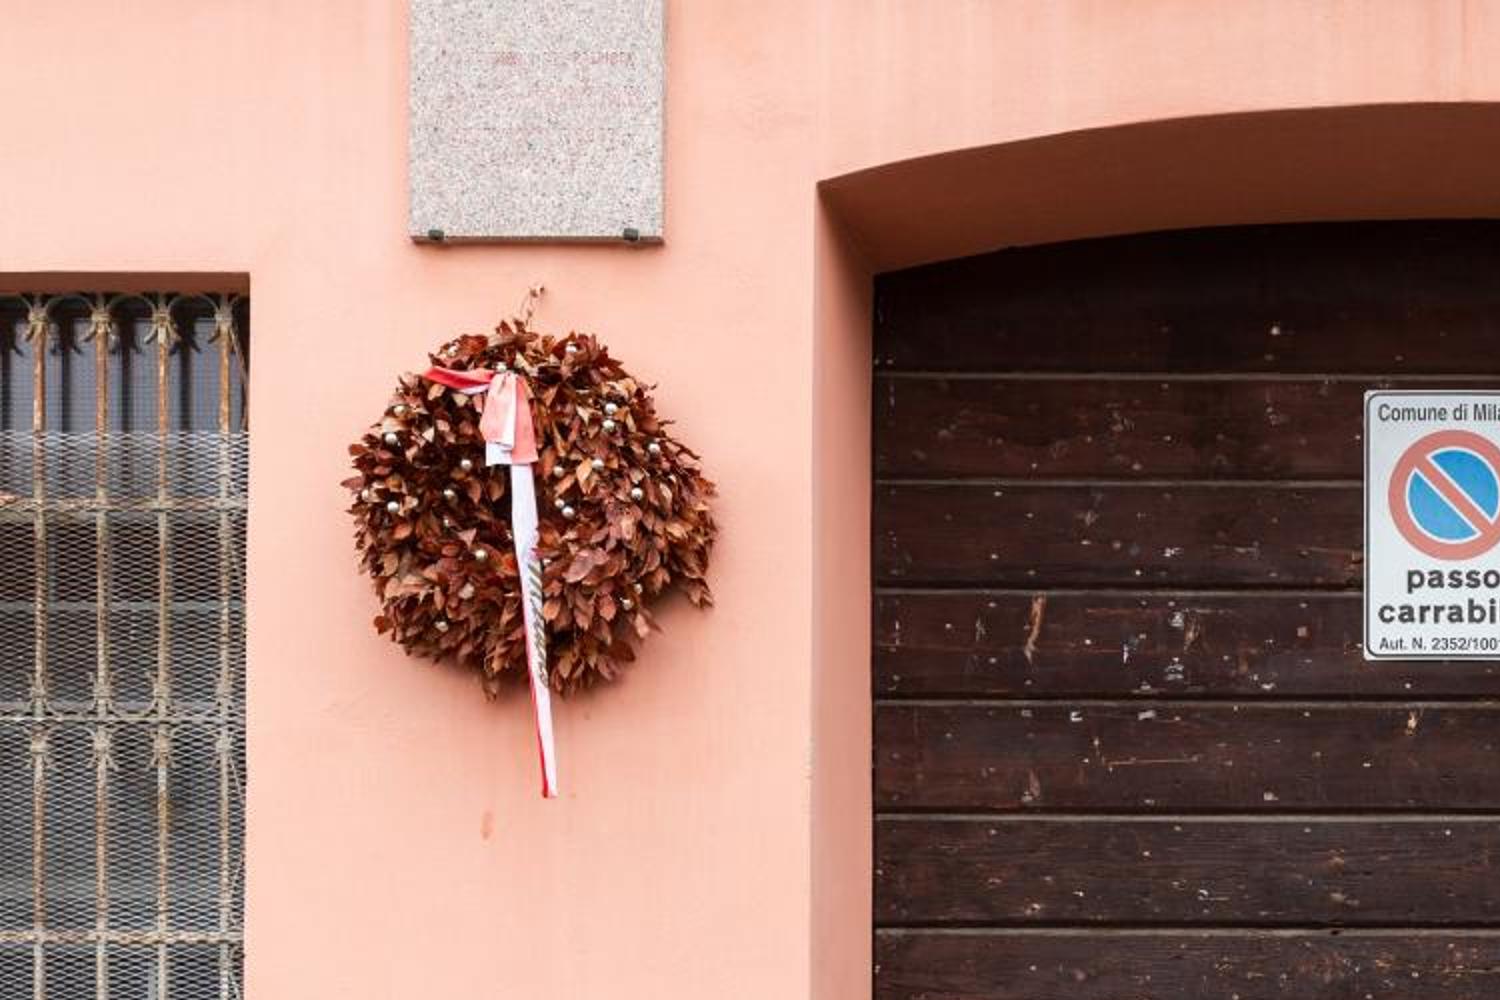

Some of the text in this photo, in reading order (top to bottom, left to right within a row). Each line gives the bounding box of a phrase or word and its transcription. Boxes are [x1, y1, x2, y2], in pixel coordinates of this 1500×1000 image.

[1378, 403, 1448, 422] Comune
[1453, 403, 1468, 421] di
[1379, 637, 1408, 650] Aut.
[1412, 637, 1427, 650] N.
